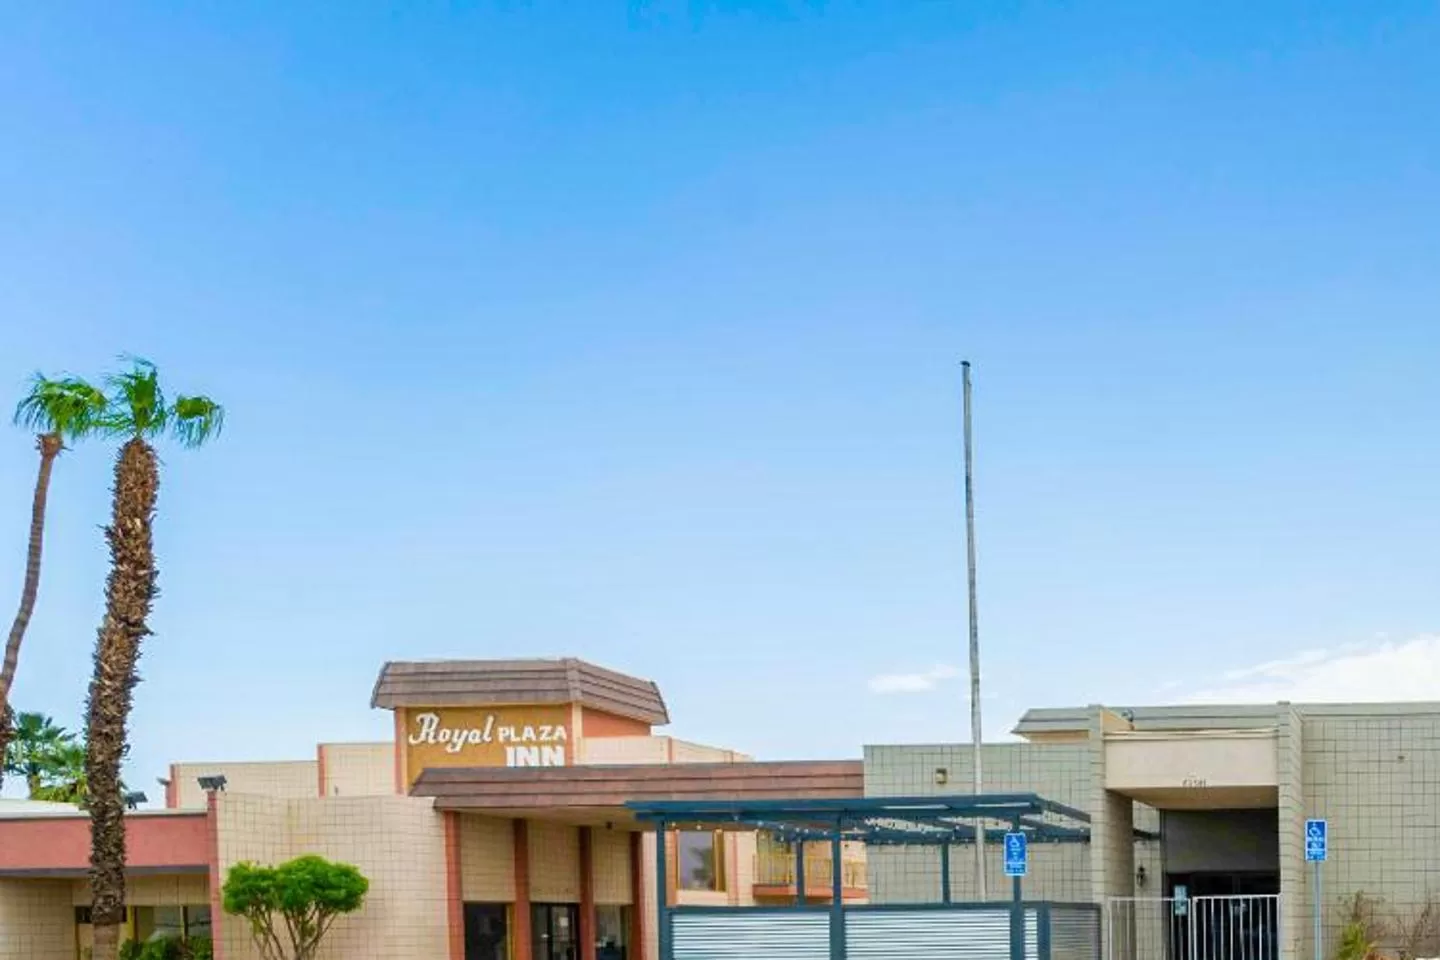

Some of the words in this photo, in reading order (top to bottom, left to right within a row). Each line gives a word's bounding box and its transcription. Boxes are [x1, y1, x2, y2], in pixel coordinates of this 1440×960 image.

[408, 712, 495, 753] Royal
[497, 725, 568, 743] PLAZA
[505, 745, 566, 768] INN
